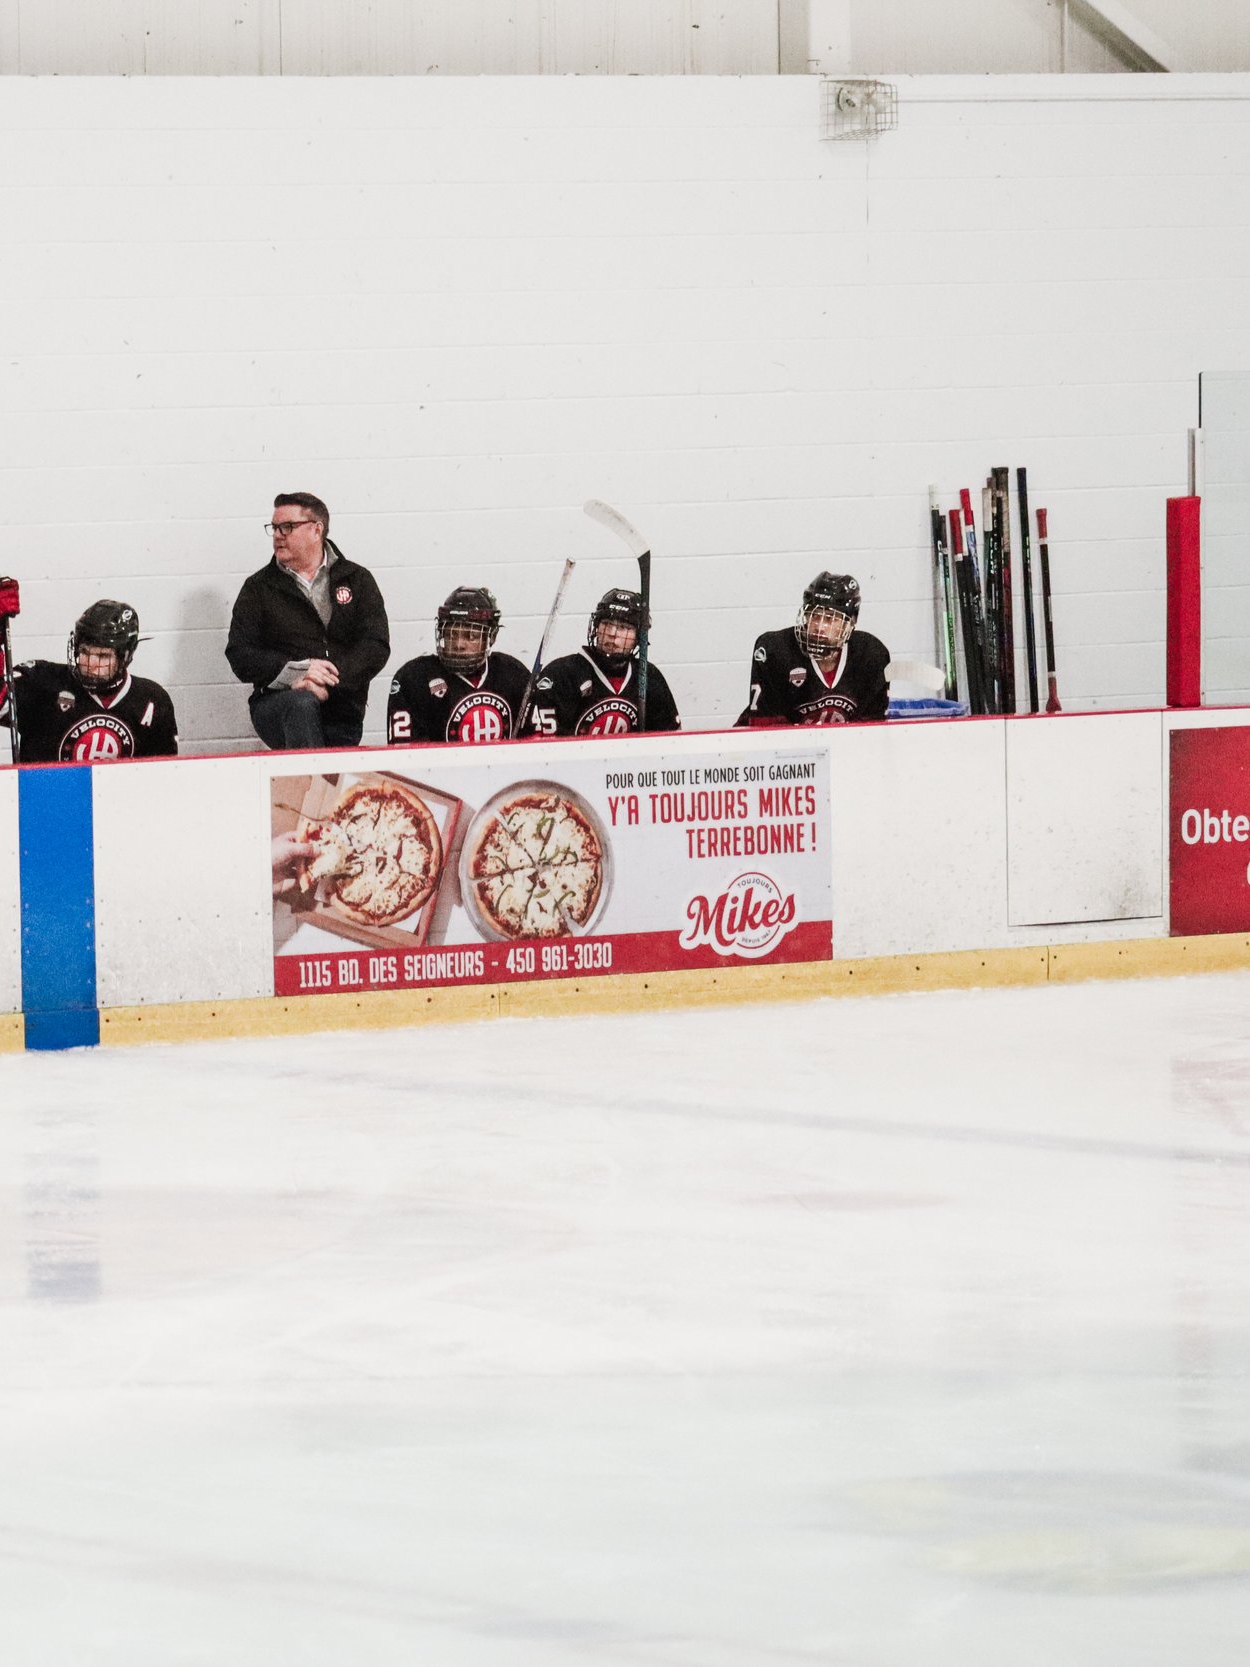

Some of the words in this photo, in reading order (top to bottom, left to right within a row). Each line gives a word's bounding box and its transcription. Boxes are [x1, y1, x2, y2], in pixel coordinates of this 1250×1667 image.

[141, 702, 154, 727] A
[453, 696, 508, 722] VELOCITY
[531, 705, 557, 735] 45
[586, 702, 638, 726] VELOCITY
[799, 699, 856, 715] VELOCIT
[71, 718, 130, 745] VELOCITY
[606, 773, 634, 789] POUR
[637, 771, 658, 787] QUE
[661, 770, 686, 786] TOUT
[689, 769, 700, 785] LE
[704, 766, 740, 783] MONDE
[743, 765, 765, 782] SOIT
[768, 762, 816, 780] GAGNANT
[649, 789, 748, 824] TOUJOURS
[759, 785, 816, 818] MIKES
[686, 823, 806, 858] TERREBONNE
[737, 878, 773, 893] TOUJOURS
[686, 886, 796, 947] Mikes
[299, 960, 332, 988] 1115
[338, 958, 364, 985] BD.
[369, 956, 398, 983] DES
[404, 950, 484, 981] SEIGNEURS
[506, 947, 536, 974] 450
[541, 942, 613, 972] 961-3030
